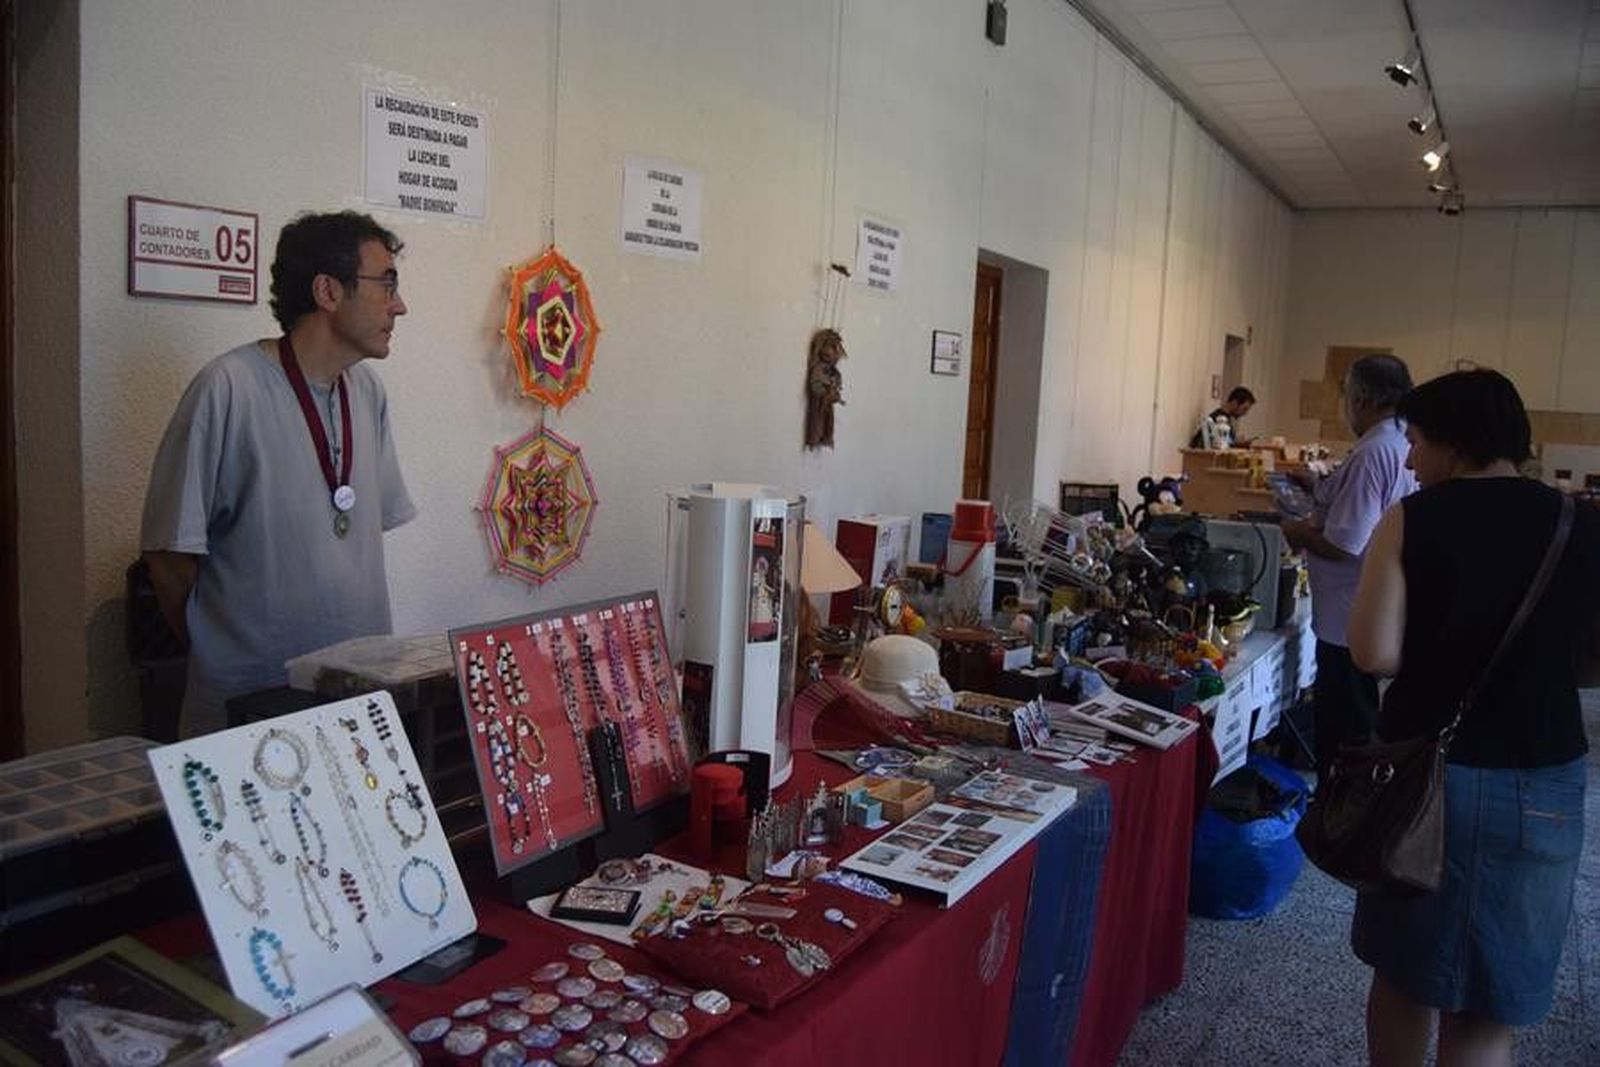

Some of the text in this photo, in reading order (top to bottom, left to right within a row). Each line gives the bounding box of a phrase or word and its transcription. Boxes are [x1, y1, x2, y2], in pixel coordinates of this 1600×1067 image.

[374, 95, 383, 108] LA
[431, 107, 440, 121] DE
[440, 108, 456, 124] ESTE
[456, 112, 479, 128] PUESTO
[407, 125, 442, 143] DESTINADA
[408, 149, 450, 168] LA LECHE DEL
[398, 170, 421, 186] HOGAR
[422, 173, 431, 187] DE
[139, 223, 251, 264] CUARTO DE 05
[139, 242, 212, 260] CONTADORES
